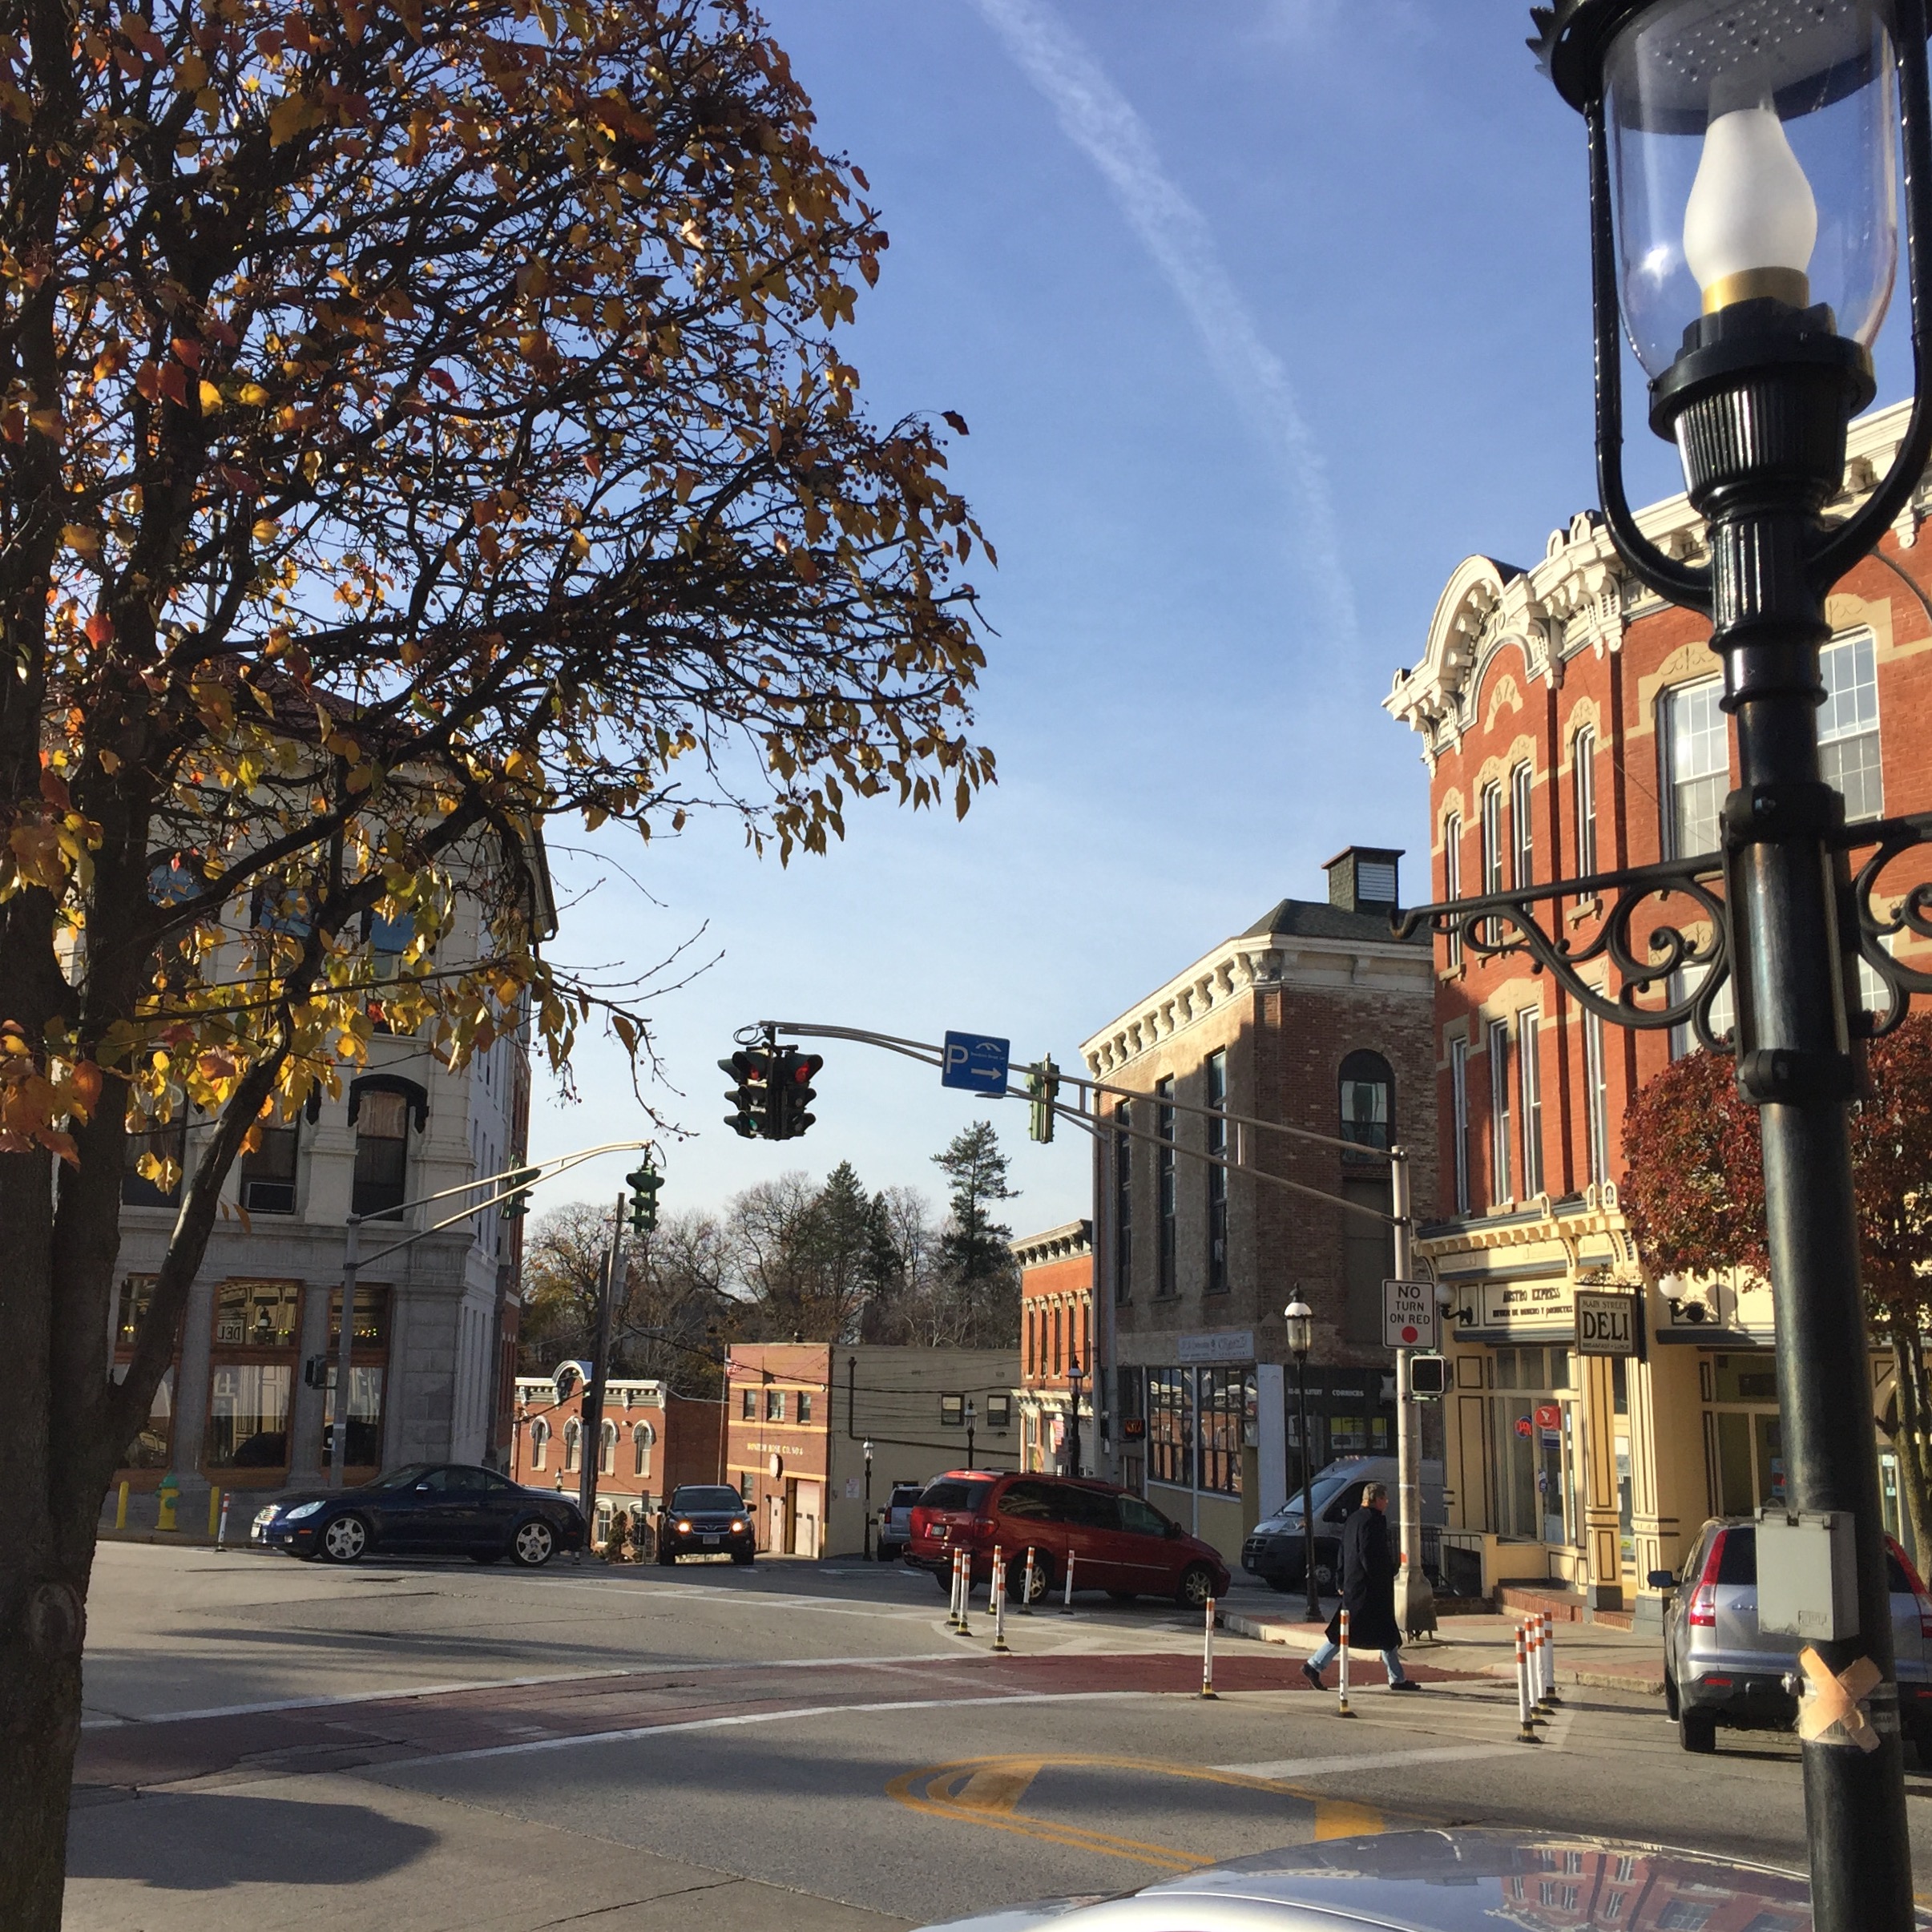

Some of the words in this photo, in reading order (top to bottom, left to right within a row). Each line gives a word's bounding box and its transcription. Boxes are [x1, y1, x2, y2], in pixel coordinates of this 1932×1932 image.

[1490, 678, 1516, 714] 1874
[946, 1043, 969, 1074] P
[1398, 1285, 1421, 1299] NO
[1531, 1288, 1561, 1301] EXPRESS
[1395, 1301, 1424, 1312] TURN
[1582, 1300, 1599, 1309] MAIN
[1603, 1301, 1627, 1310] STREET
[1390, 1313, 1404, 1324] ON
[1408, 1314, 1430, 1325] RED
[1583, 1310, 1629, 1341] DELI
